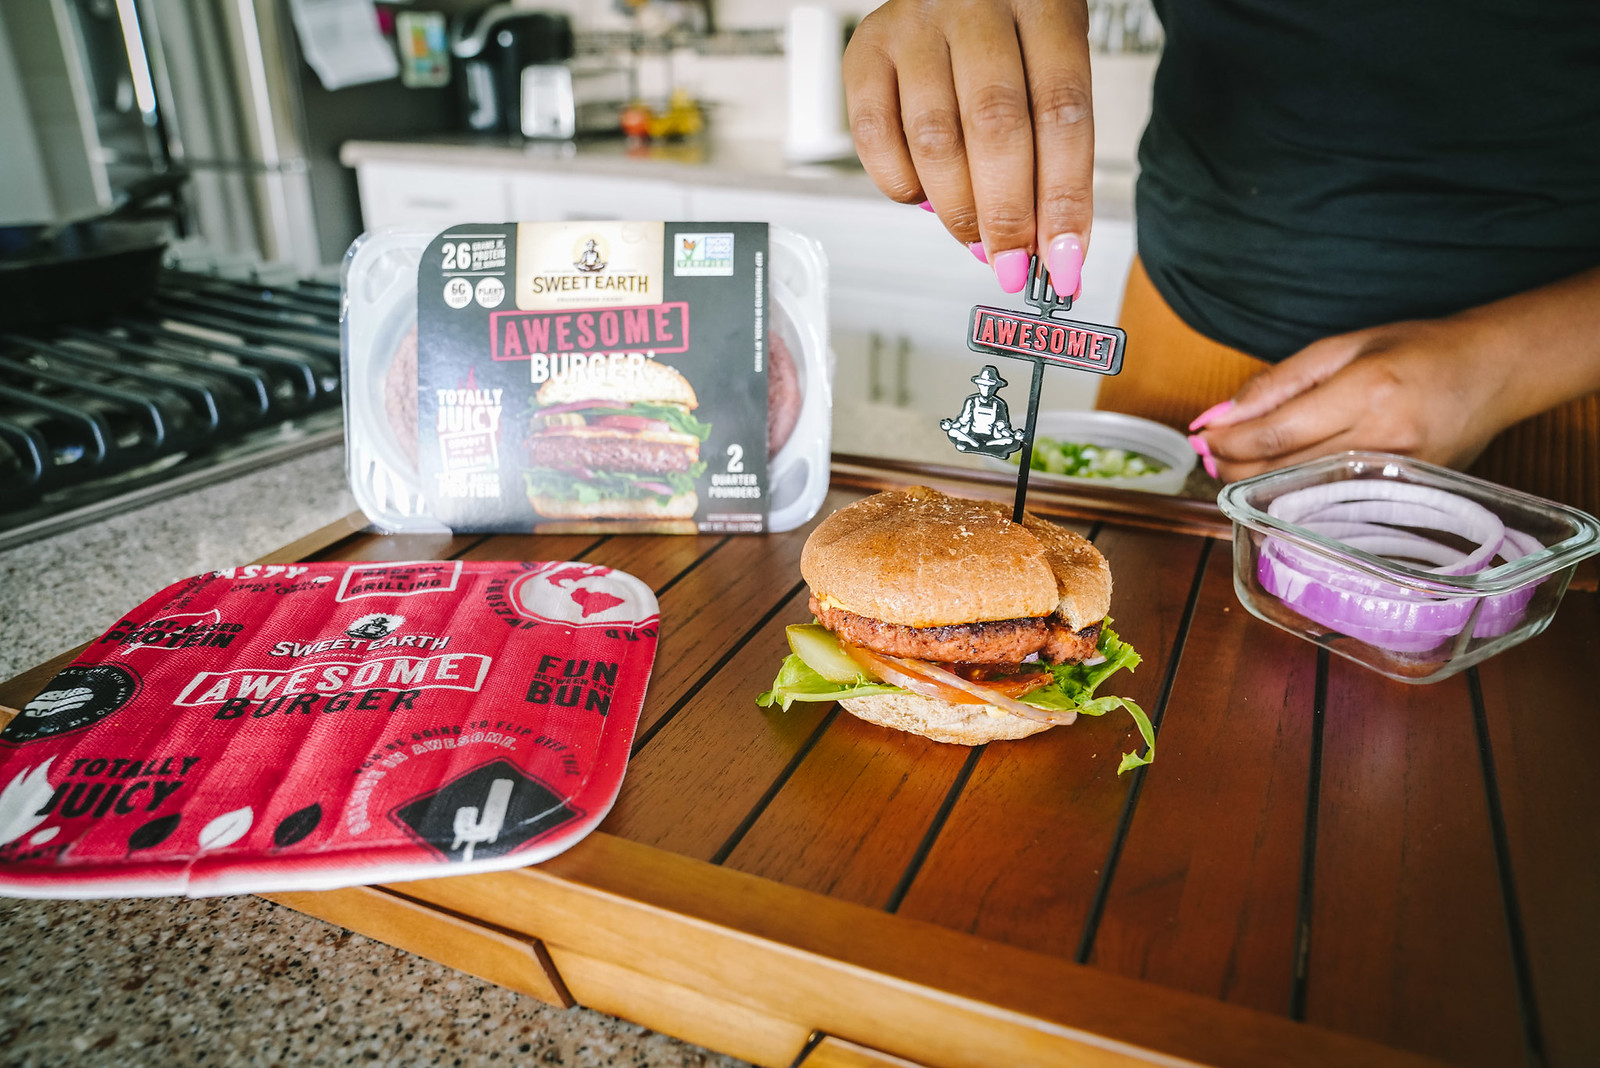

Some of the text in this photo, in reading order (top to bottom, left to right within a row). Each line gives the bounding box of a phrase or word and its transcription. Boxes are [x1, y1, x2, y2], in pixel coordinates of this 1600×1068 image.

[441, 242, 471, 270] 26
[451, 283, 466, 295] 6G
[533, 276, 648, 294] SWEET EARTH
[504, 308, 673, 356] AWESOME
[981, 317, 1104, 361] AWESOME
[530, 352, 645, 384] BURGER
[436, 388, 503, 406] TOTALLY
[437, 405, 502, 432] JUICY
[727, 444, 744, 472] 2
[351, 579, 441, 595] GRILLING
[100, 630, 236, 649] PROTEIN
[270, 635, 451, 658] SWEET EARTH
[196, 656, 465, 703] AWESOME
[534, 673, 588, 685] BETWEEN
[537, 655, 618, 686] FUN
[213, 689, 421, 720] BURGER
[525, 680, 610, 717] BUN
[412, 726, 461, 741] GOING
[471, 720, 488, 729] TO
[496, 721, 531, 735] FLIP
[67, 757, 200, 779] TOTALLY
[34, 781, 185, 818] JUICY
